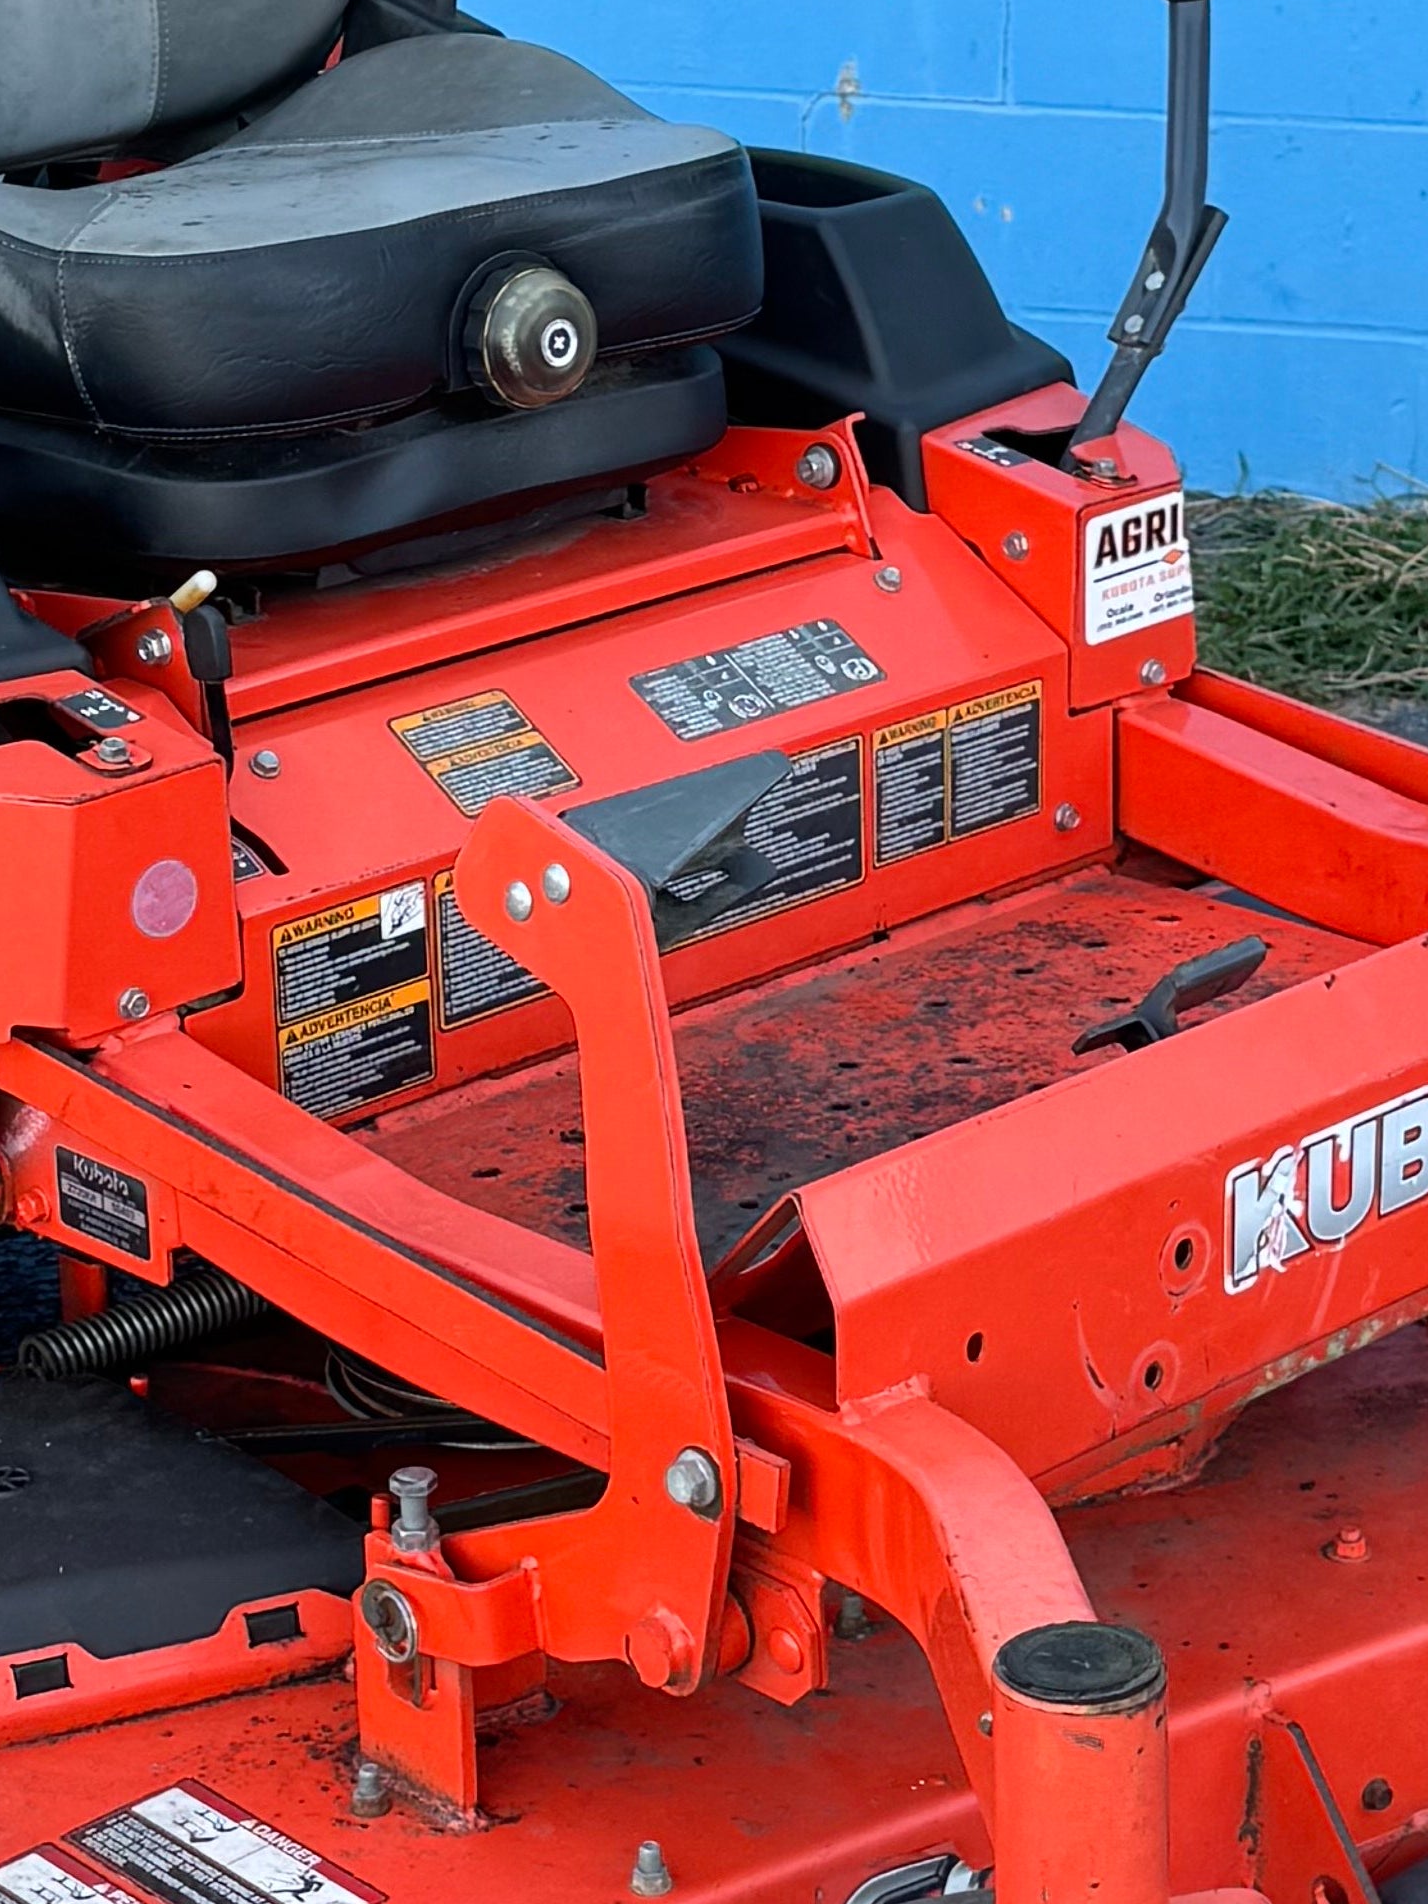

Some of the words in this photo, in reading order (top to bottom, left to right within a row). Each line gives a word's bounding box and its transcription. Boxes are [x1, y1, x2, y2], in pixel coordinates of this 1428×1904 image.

[1094, 502, 1179, 570] AGRI
[1102, 573, 1156, 601] KUBOTA
[292, 906, 356, 937] WARNING
[299, 996, 392, 1039] ADVERTENCIA
[74, 1153, 130, 1196] Kubota
[256, 1824, 322, 1868] DANGER
